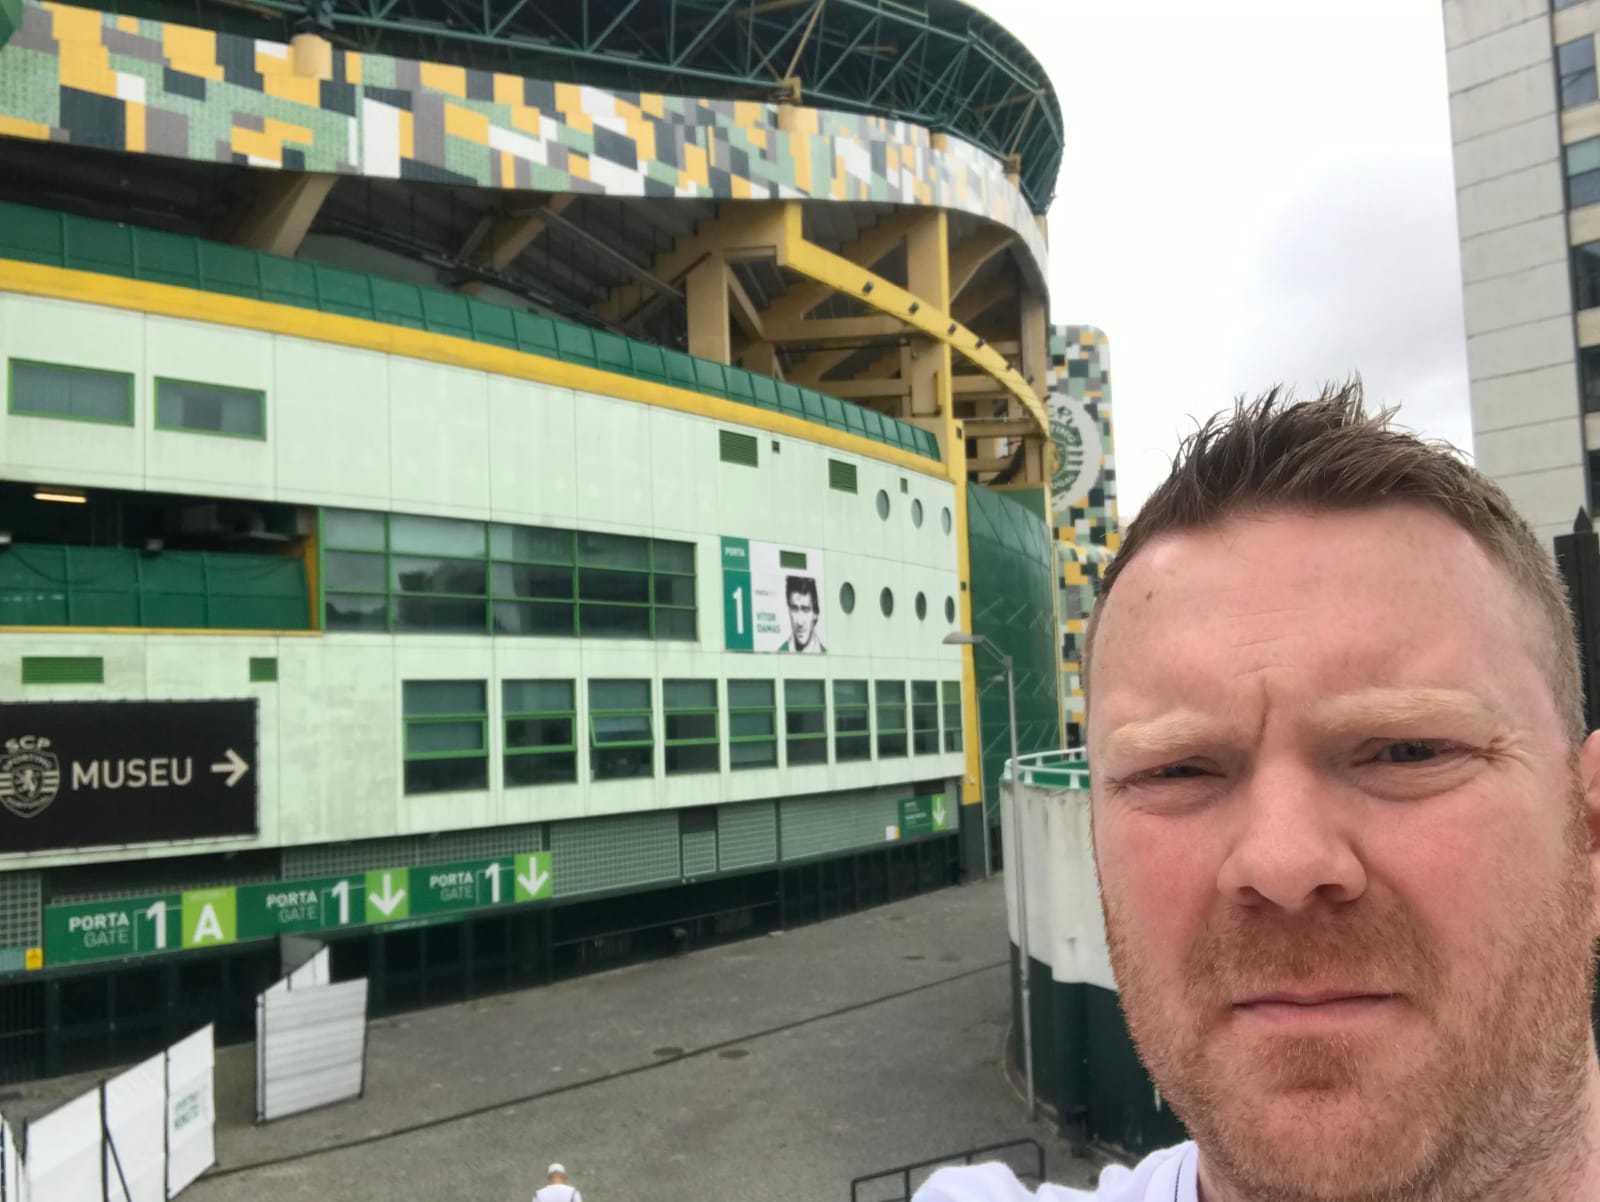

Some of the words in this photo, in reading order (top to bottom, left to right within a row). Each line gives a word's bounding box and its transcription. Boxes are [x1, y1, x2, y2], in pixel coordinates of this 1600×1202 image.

[725, 546, 746, 557] PORTA
[732, 586, 744, 635] 1
[757, 623, 782, 634] DAMAS
[4, 735, 52, 752] SCP
[71, 756, 193, 791] MUSEU
[430, 871, 473, 888] PORTA
[485, 862, 500, 904] 1
[266, 890, 318, 909] PORTA
[331, 880, 349, 925] 1
[440, 885, 473, 901] GATE
[278, 905, 318, 922] GATE
[68, 912, 130, 933] PORTA
[146, 900, 167, 950] 1
[192, 903, 225, 944] A
[83, 929, 129, 948] GATE
